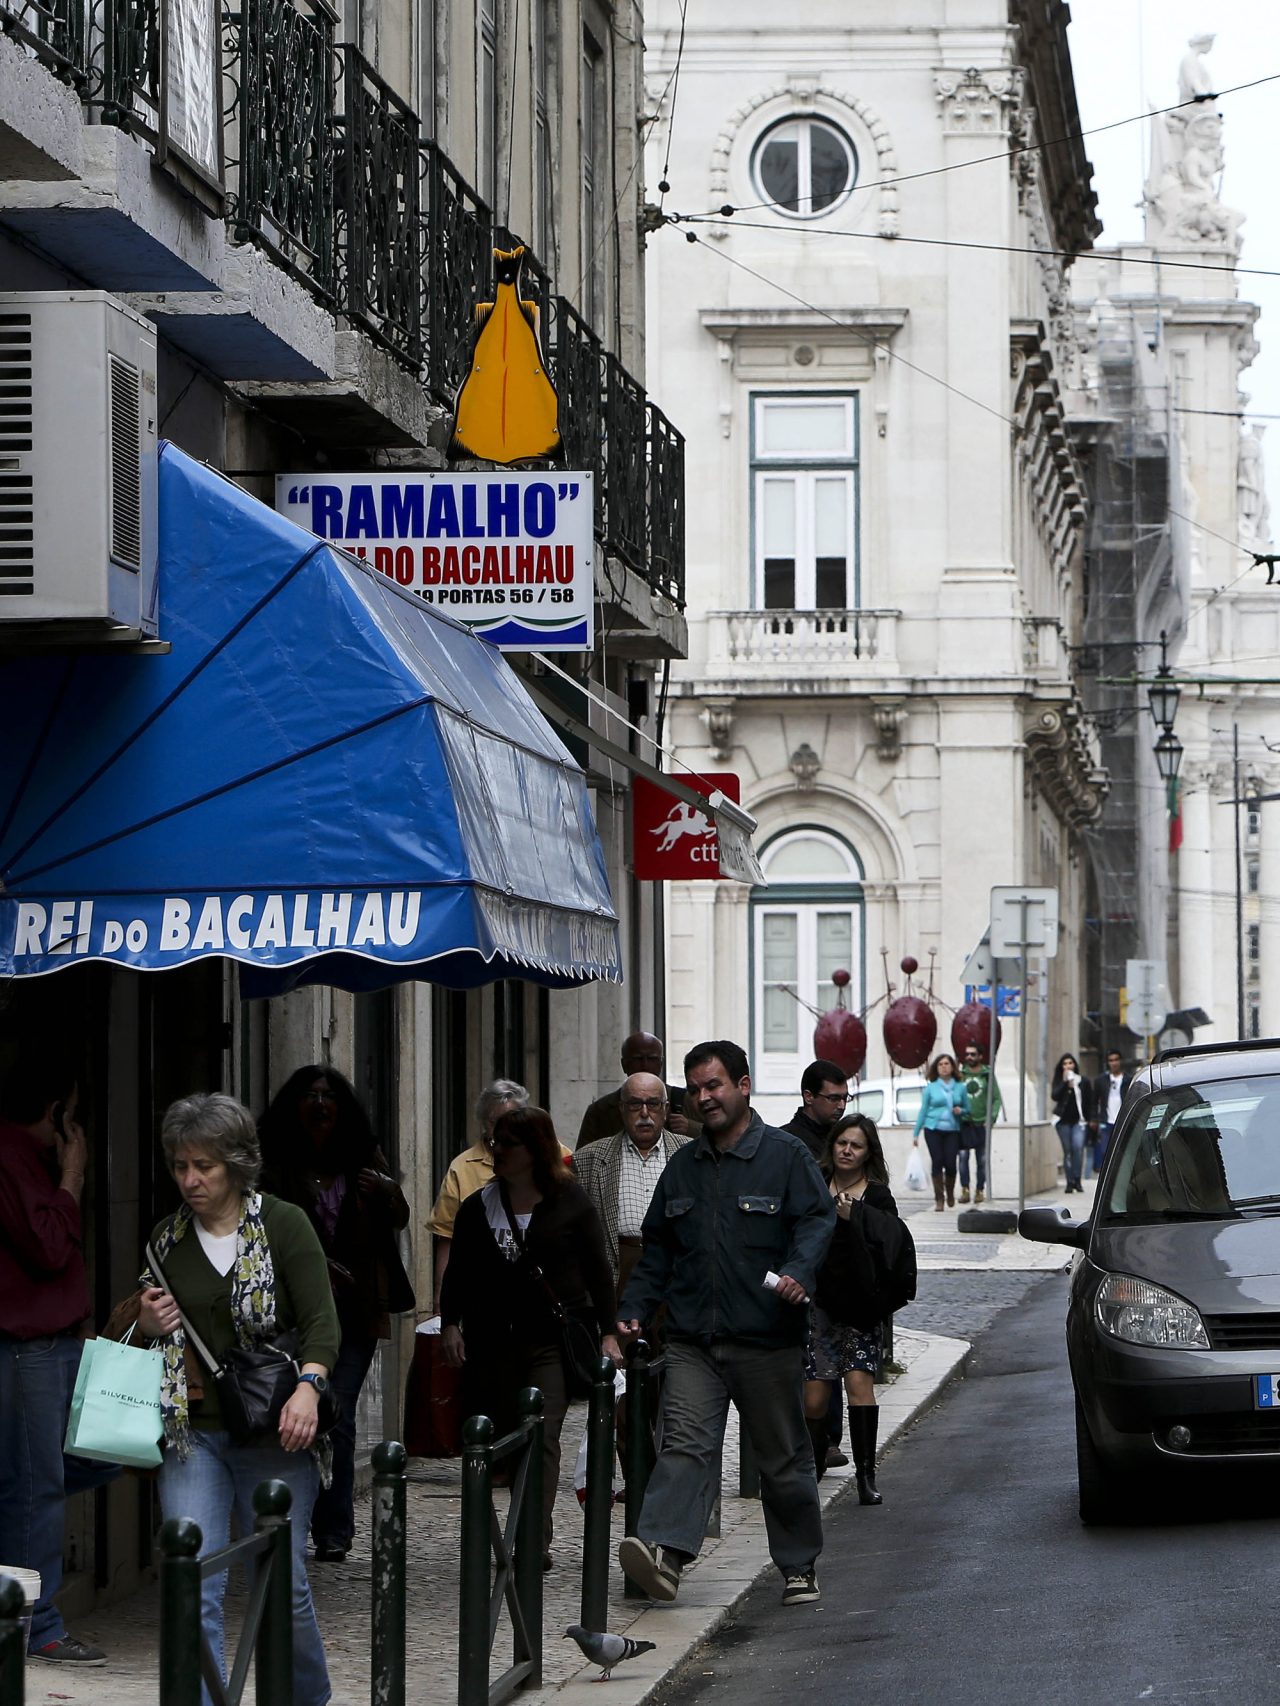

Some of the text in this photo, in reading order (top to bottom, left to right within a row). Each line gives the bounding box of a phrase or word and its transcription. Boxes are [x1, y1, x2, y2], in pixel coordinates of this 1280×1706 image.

[375, 545, 574, 586] DO BACALHAU
[438, 589, 506, 604] PORTAS
[510, 589, 533, 604] 56
[551, 588, 574, 603] 58
[690, 843, 718, 862] ctt
[13, 900, 94, 956] REI
[103, 919, 148, 954] DO
[160, 891, 422, 951] BACALHAU
[100, 1389, 160, 1409] SILVERLAND
